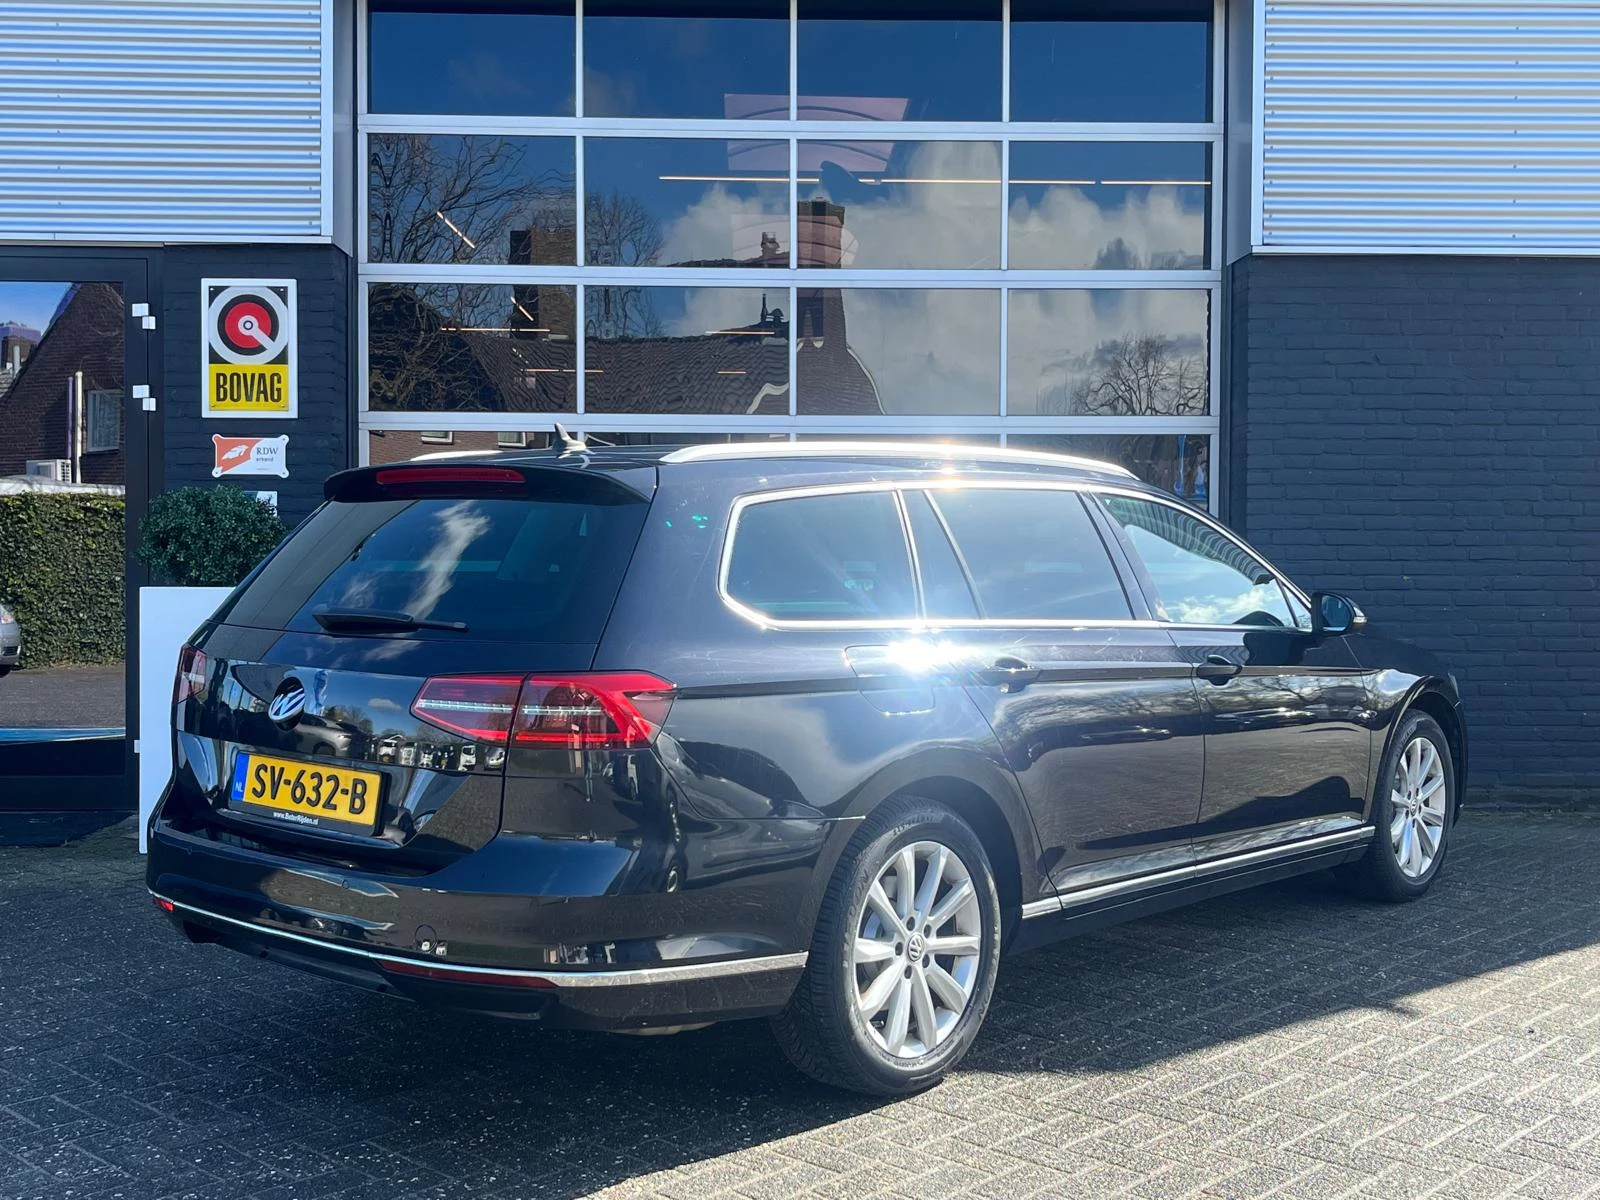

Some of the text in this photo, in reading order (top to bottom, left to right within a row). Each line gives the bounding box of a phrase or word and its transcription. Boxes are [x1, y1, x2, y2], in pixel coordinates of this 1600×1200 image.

[215, 372, 283, 403] BOVAG
[256, 447, 279, 455] RDW
[234, 781, 244, 793] NL
[251, 763, 368, 815] SV-632-B
